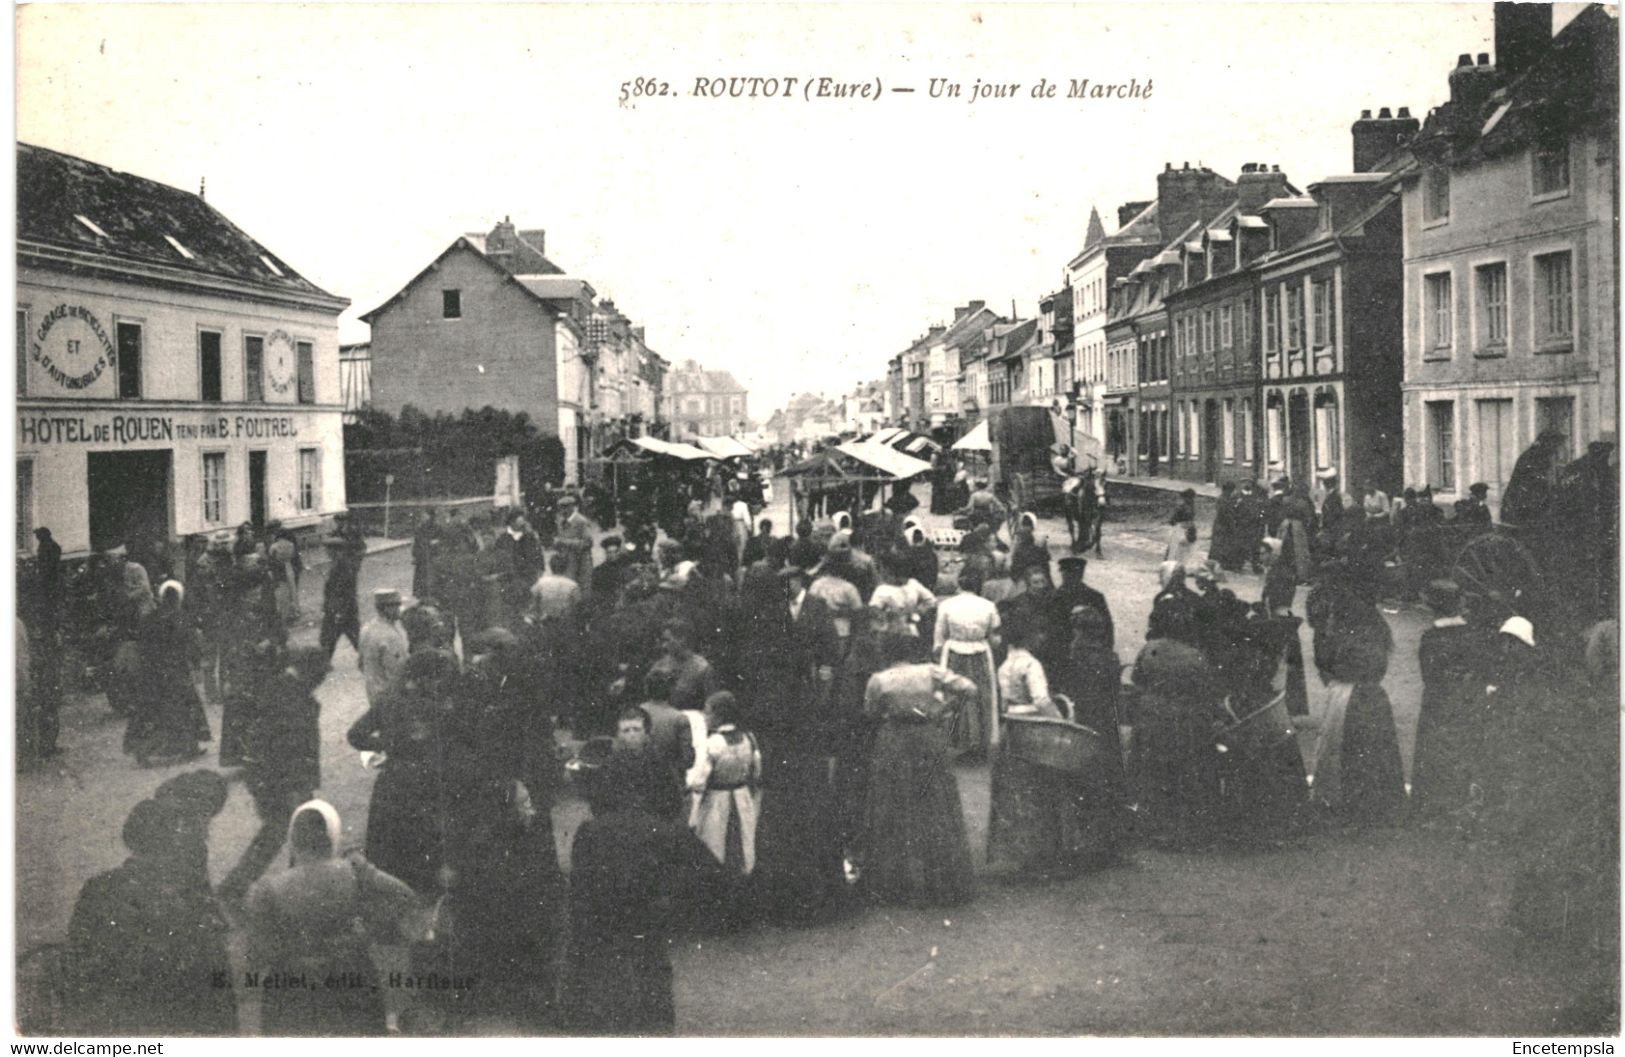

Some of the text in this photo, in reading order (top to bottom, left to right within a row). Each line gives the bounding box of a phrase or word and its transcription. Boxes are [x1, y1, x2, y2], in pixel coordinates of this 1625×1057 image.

[618, 76, 678, 101] 5862.
[692, 77, 798, 98] ROUTOT
[804, 76, 883, 101] (Eure)
[929, 78, 961, 98] Un
[972, 78, 1021, 101] jour
[1030, 78, 1057, 99] de
[1066, 78, 1153, 99] Marché
[67, 339, 80, 354] ET
[94, 425, 110, 442] DE
[113, 415, 172, 444] ROUEN
[236, 415, 298, 438] FOUTREL
